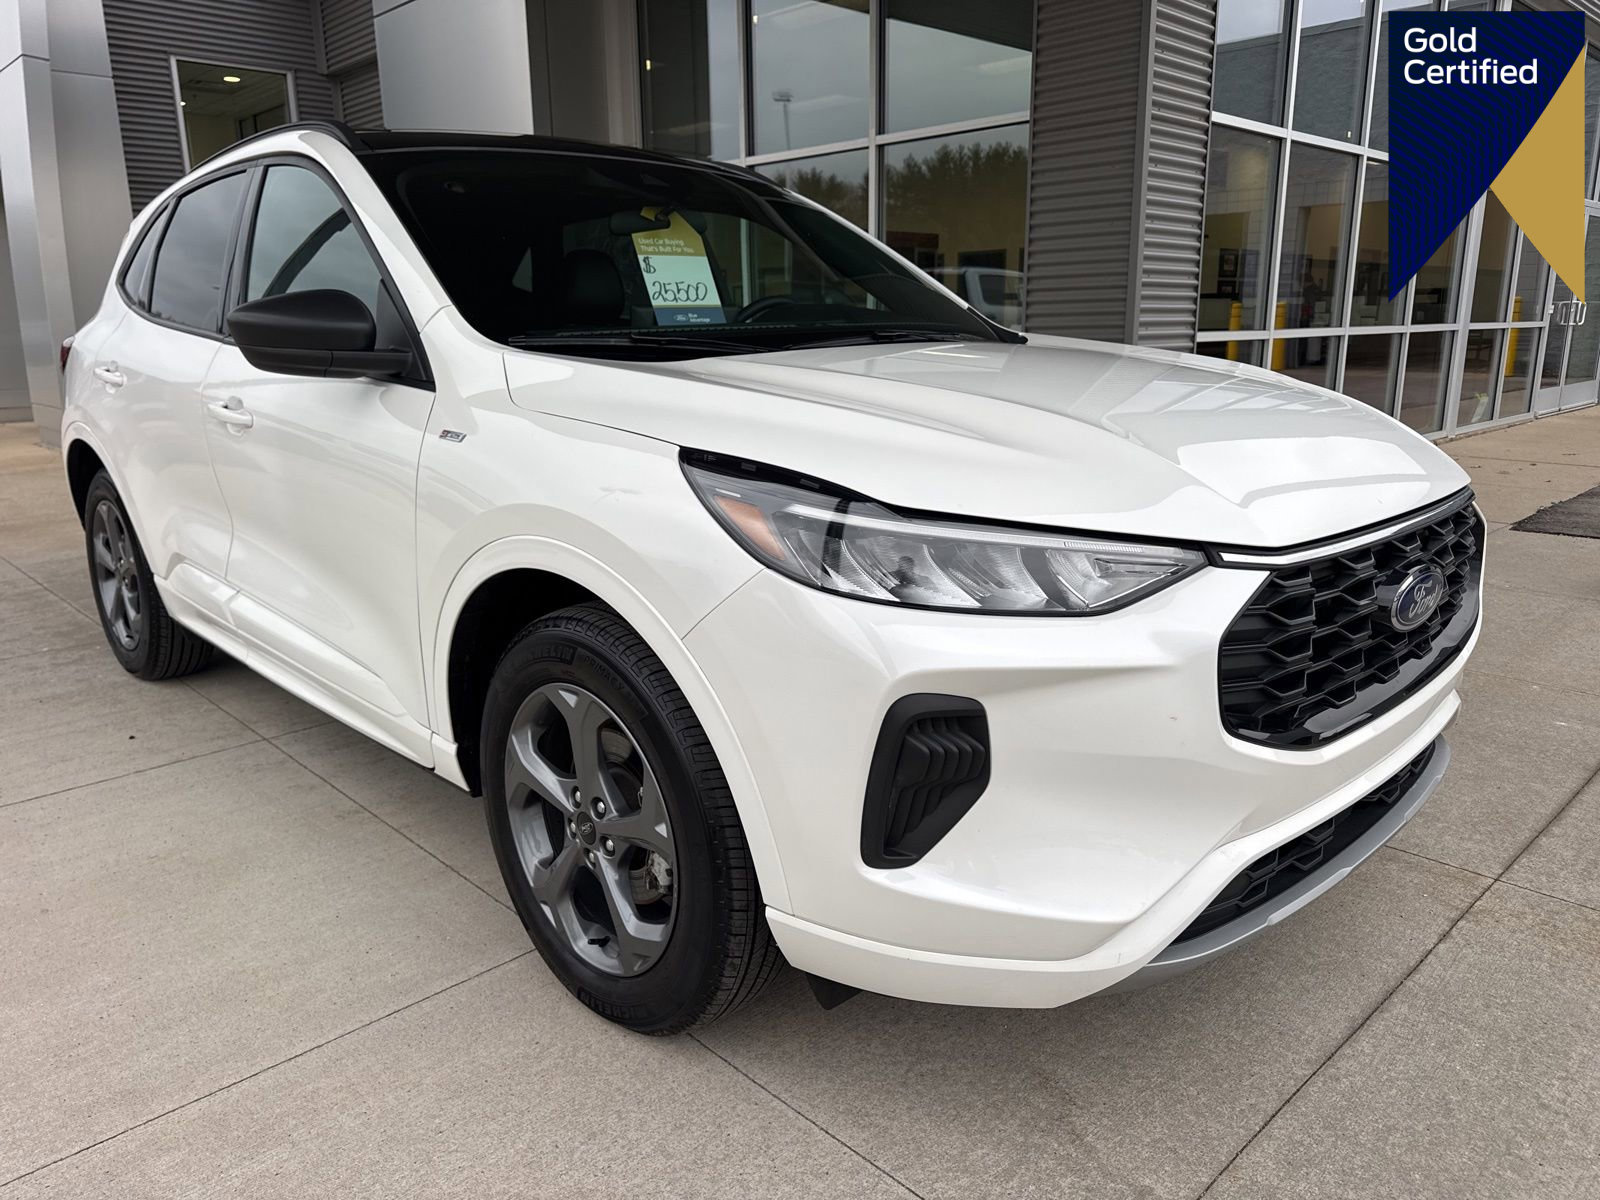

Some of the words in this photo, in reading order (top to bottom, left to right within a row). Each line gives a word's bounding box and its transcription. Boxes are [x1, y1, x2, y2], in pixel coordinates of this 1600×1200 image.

[642, 256, 656, 274] $
[1408, 579, 1439, 619] Ford
[582, 655, 624, 691] PRIMACY
